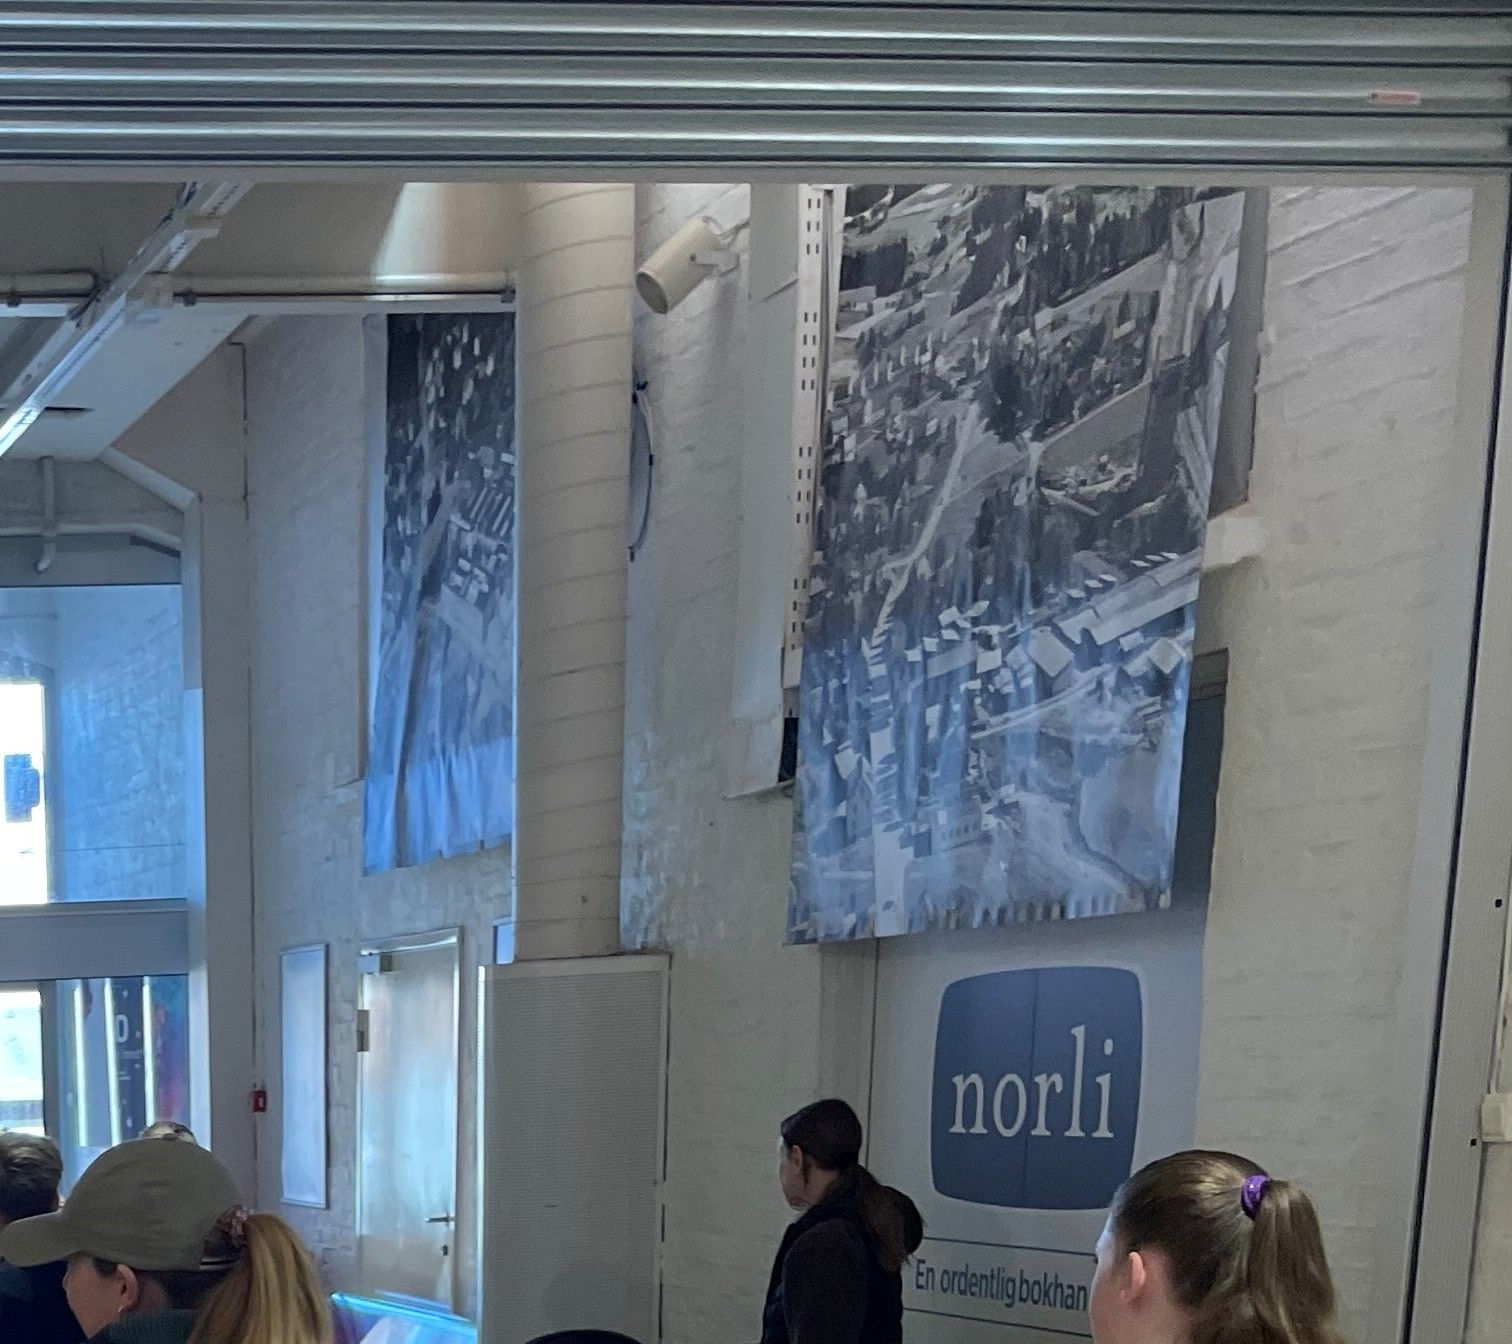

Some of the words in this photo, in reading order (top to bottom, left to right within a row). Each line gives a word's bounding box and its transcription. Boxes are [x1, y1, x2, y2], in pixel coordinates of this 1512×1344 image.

[948, 1024, 1115, 1138] norli
[915, 1258, 935, 1291] En
[940, 1263, 1016, 1308] ordentlig
[1019, 1269, 1088, 1312] bokhan
